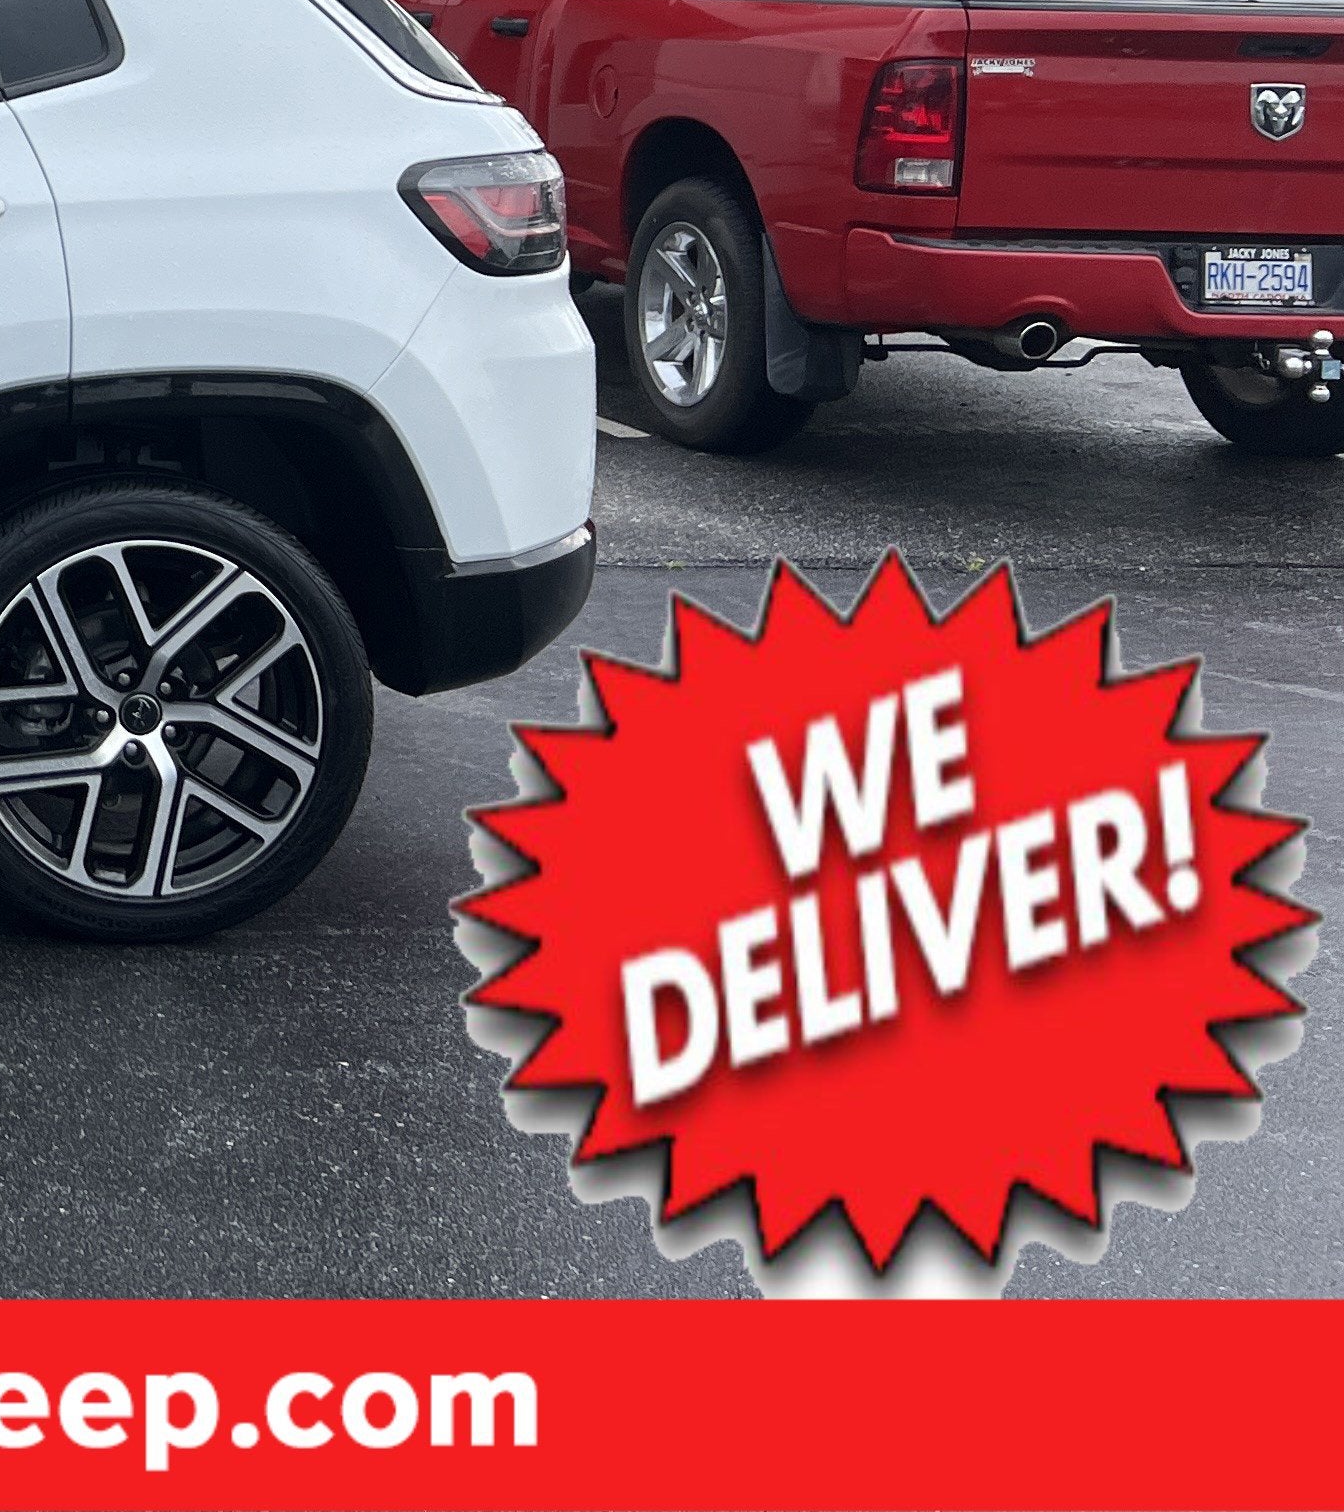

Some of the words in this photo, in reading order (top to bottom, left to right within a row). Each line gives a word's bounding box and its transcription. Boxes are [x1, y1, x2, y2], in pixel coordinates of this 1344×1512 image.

[972, 58, 1002, 66] JACKY
[1004, 58, 1036, 66] JONES
[1228, 248, 1257, 259] JACKY
[1260, 248, 1291, 260] JONES
[1207, 262, 1310, 292] RKH-2594
